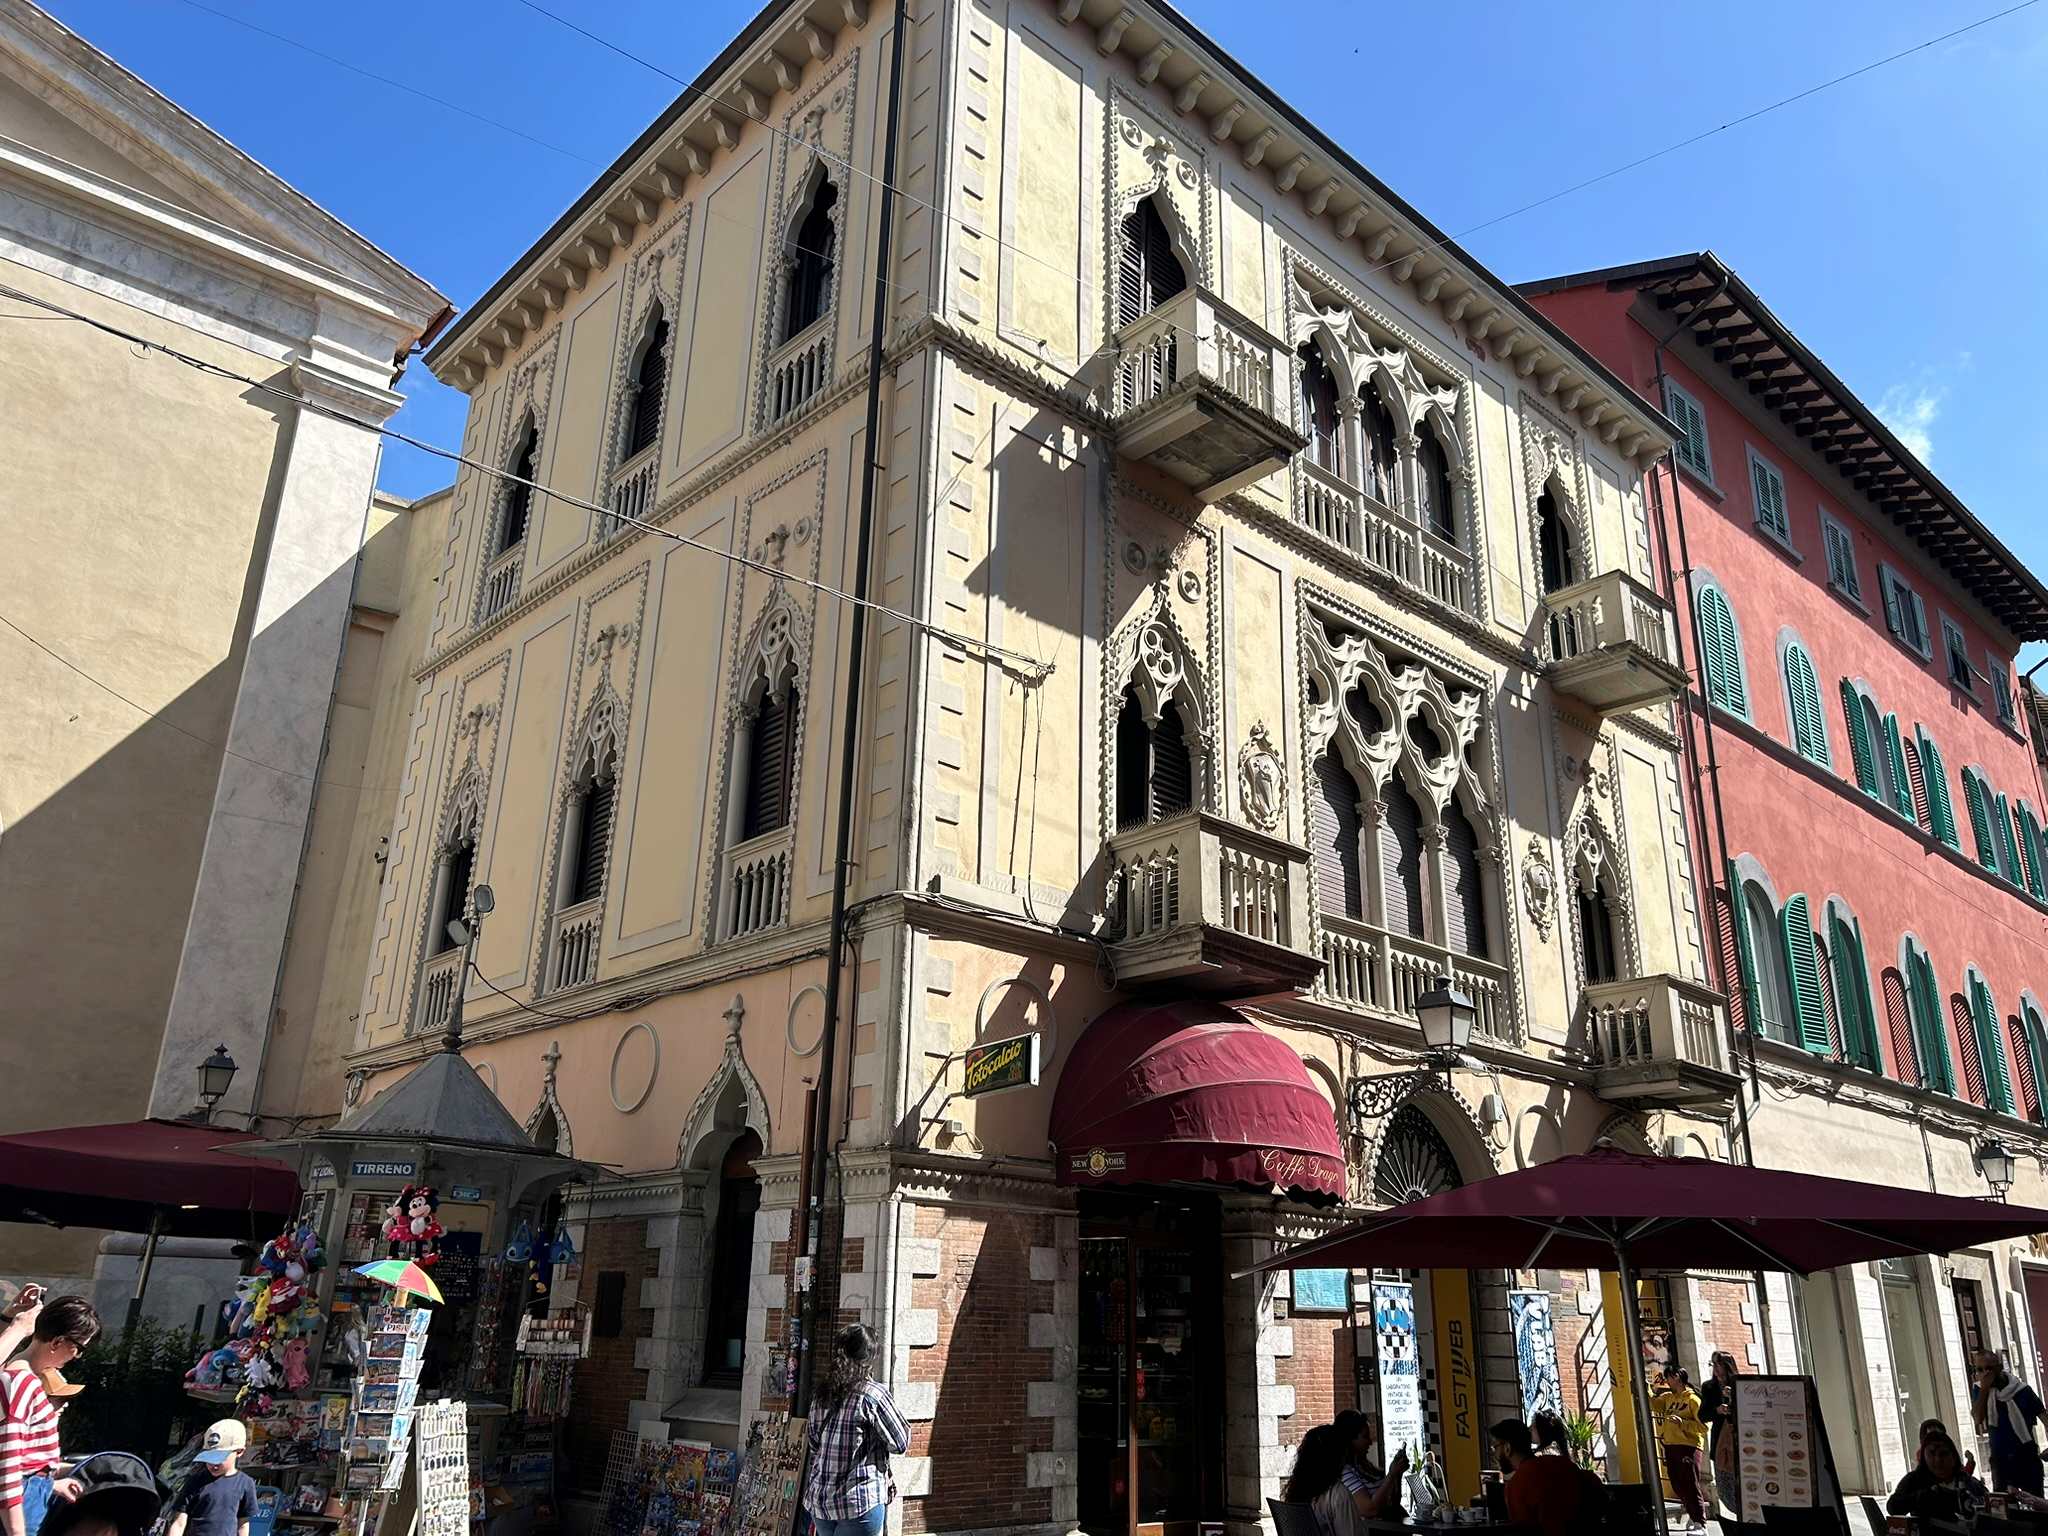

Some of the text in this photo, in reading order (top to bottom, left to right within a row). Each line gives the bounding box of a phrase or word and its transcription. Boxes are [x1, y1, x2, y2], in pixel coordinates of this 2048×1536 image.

[966, 1040, 1023, 1089] Totocalcio
[355, 1163, 412, 1175] TIRRENO
[1072, 1157, 1125, 1168] NEW YORK
[1308, 1156, 1339, 1188] Drago
[1448, 1319, 1472, 1439] FASTWEB
